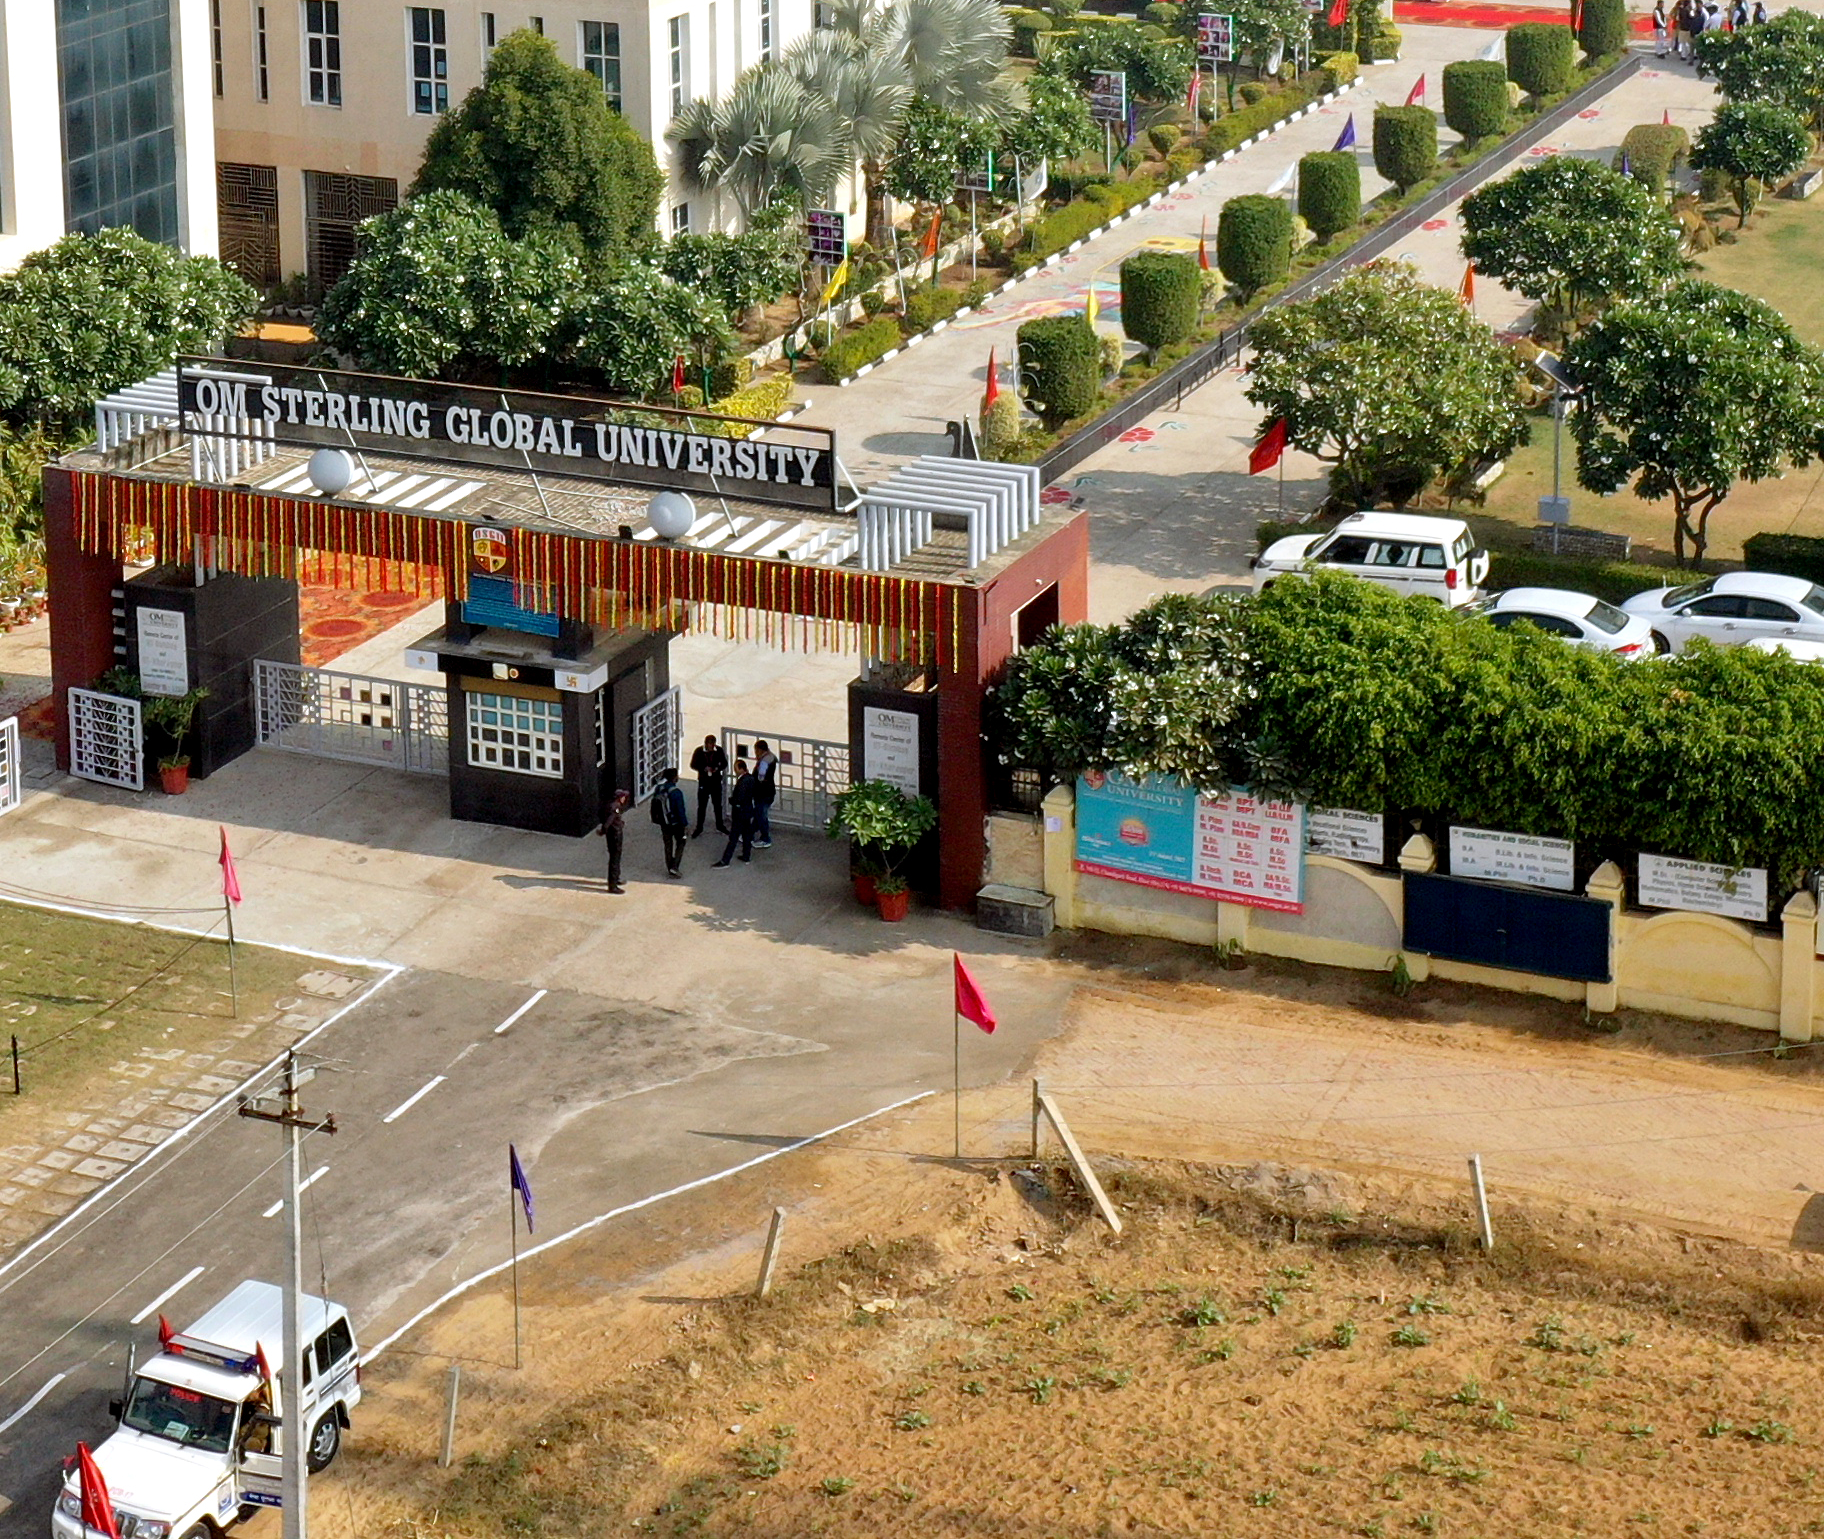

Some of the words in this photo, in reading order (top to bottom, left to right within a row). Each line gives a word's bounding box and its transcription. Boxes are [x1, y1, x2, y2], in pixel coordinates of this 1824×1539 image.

[196, 378, 247, 418] OM
[261, 386, 430, 439] STERLING
[445, 405, 582, 458] GLOBAL
[594, 422, 820, 487] UNIVERSITY
[1106, 784, 1184, 807] UNIVERSITY
[1666, 860, 1706, 873] APPLIED
[1233, 870, 1252, 879] BCA
[1232, 878, 1255, 889] MCA
